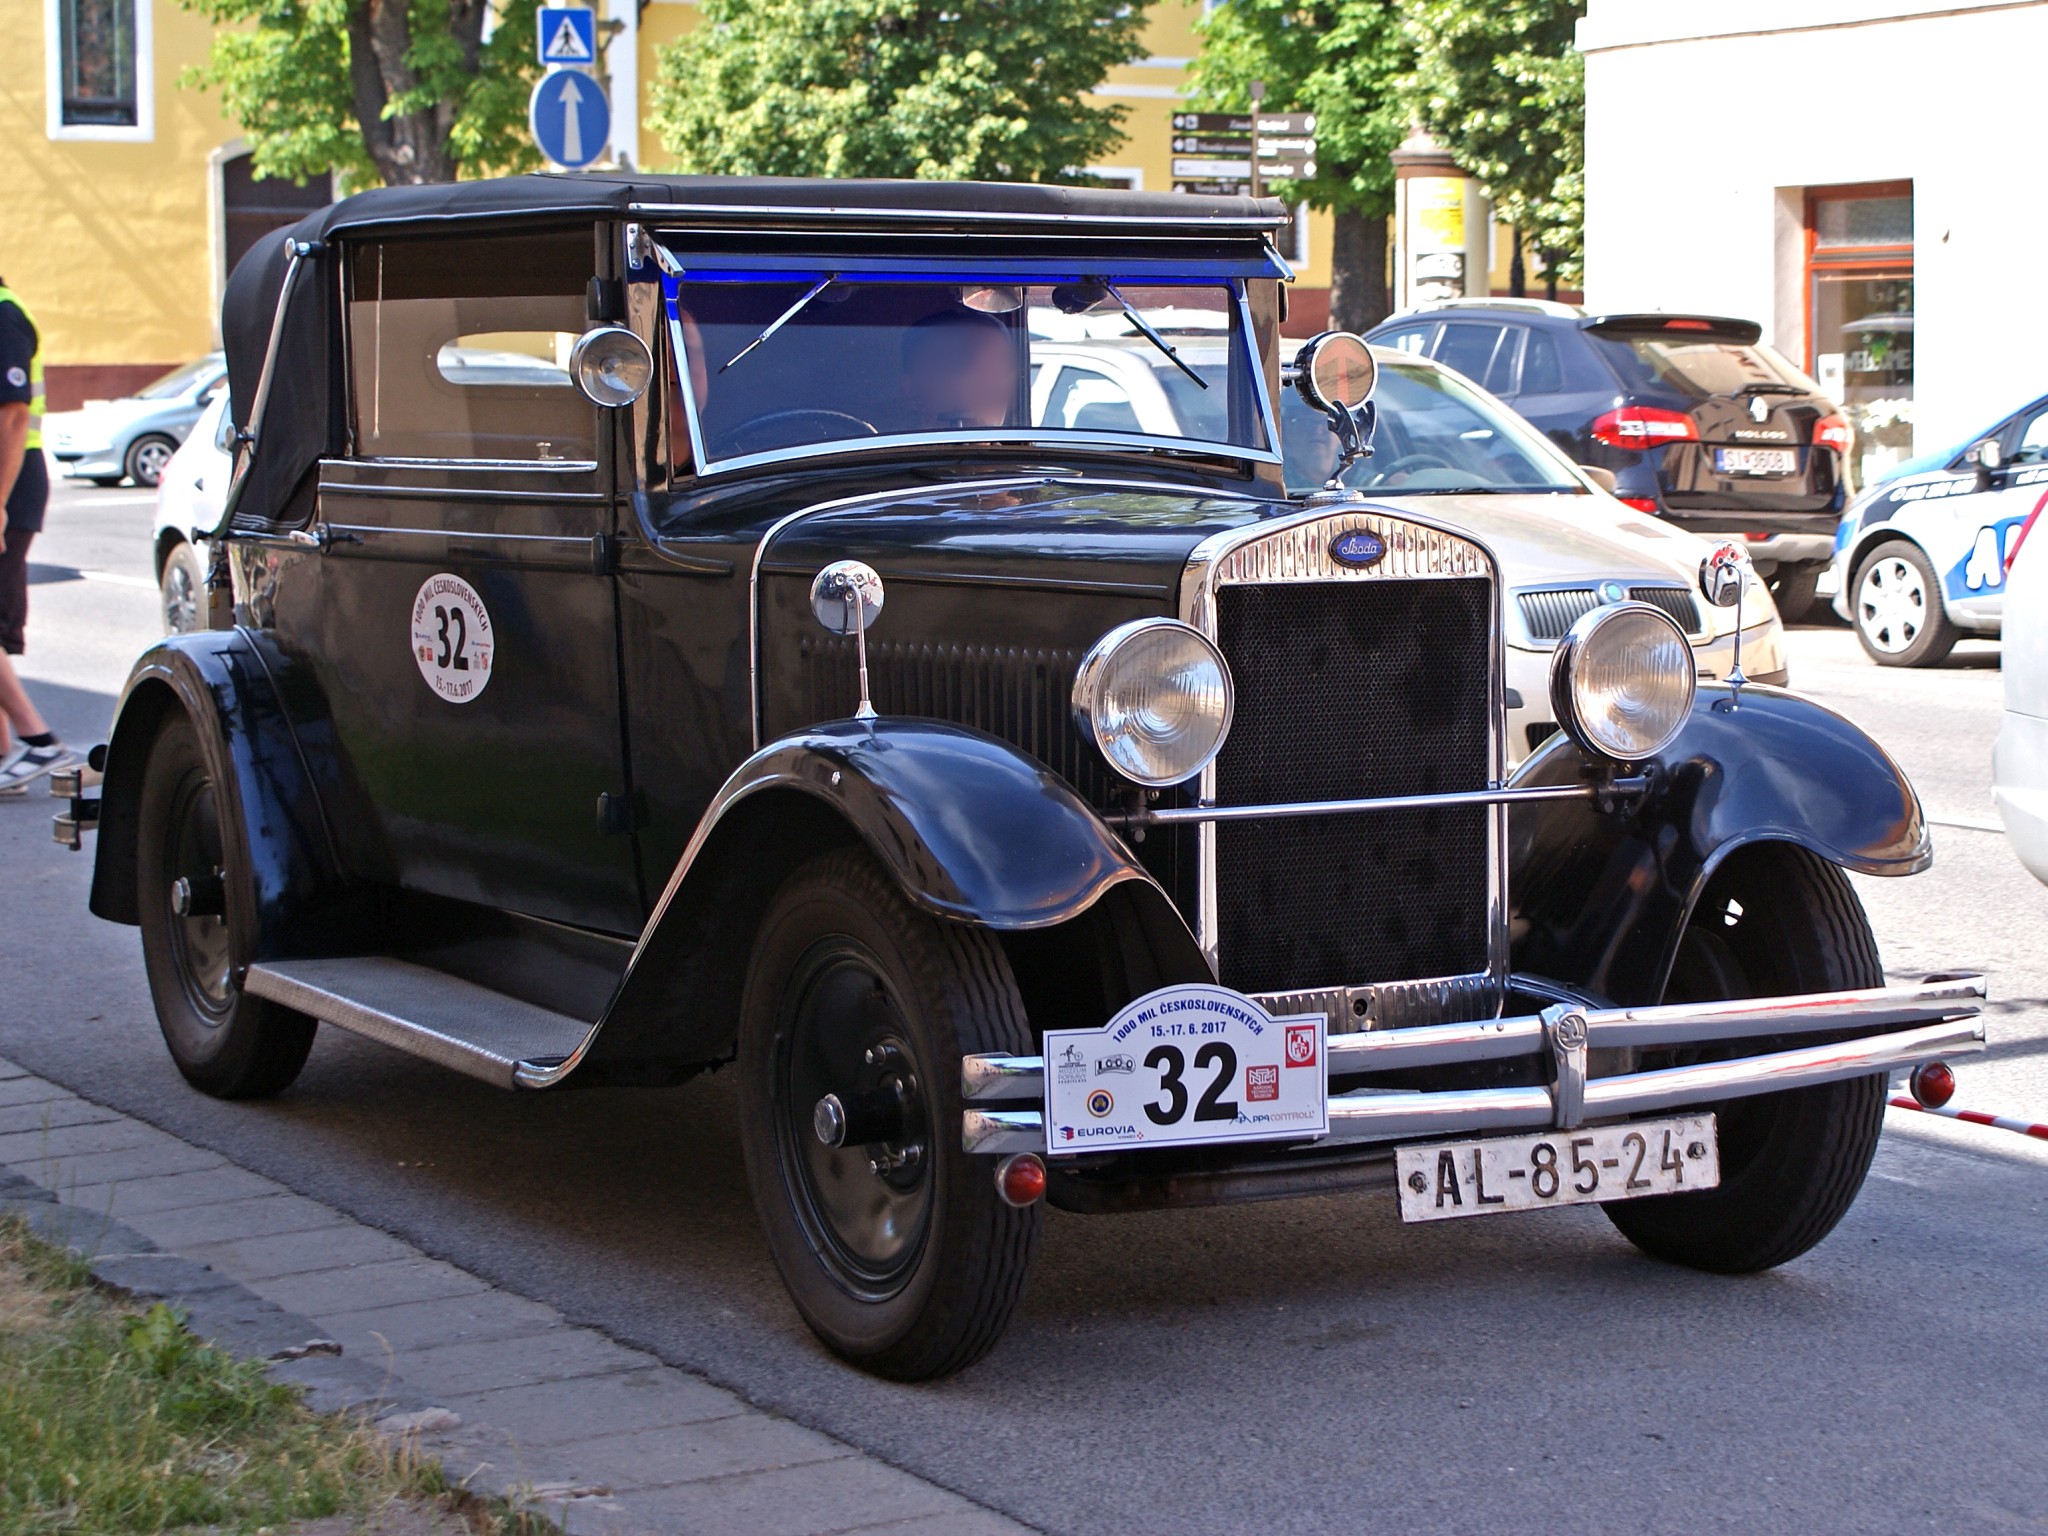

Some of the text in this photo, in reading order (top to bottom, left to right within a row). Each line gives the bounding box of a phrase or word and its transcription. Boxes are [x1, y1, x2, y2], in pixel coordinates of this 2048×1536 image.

[1342, 537, 1377, 555] Škoda
[415, 598, 426, 624] 1000
[433, 579, 489, 632] ČESKOSLOVENSKÝCH
[435, 605, 469, 671] 32
[1112, 999, 1264, 1044] 1000 MIL ČESKOSLOVENSKÝCH
[1201, 1021, 1227, 1034] 2017
[1143, 1041, 1239, 1126] 32
[1078, 1125, 1136, 1137] EUROVIA
[1435, 1129, 1685, 1208] AL-85-24
